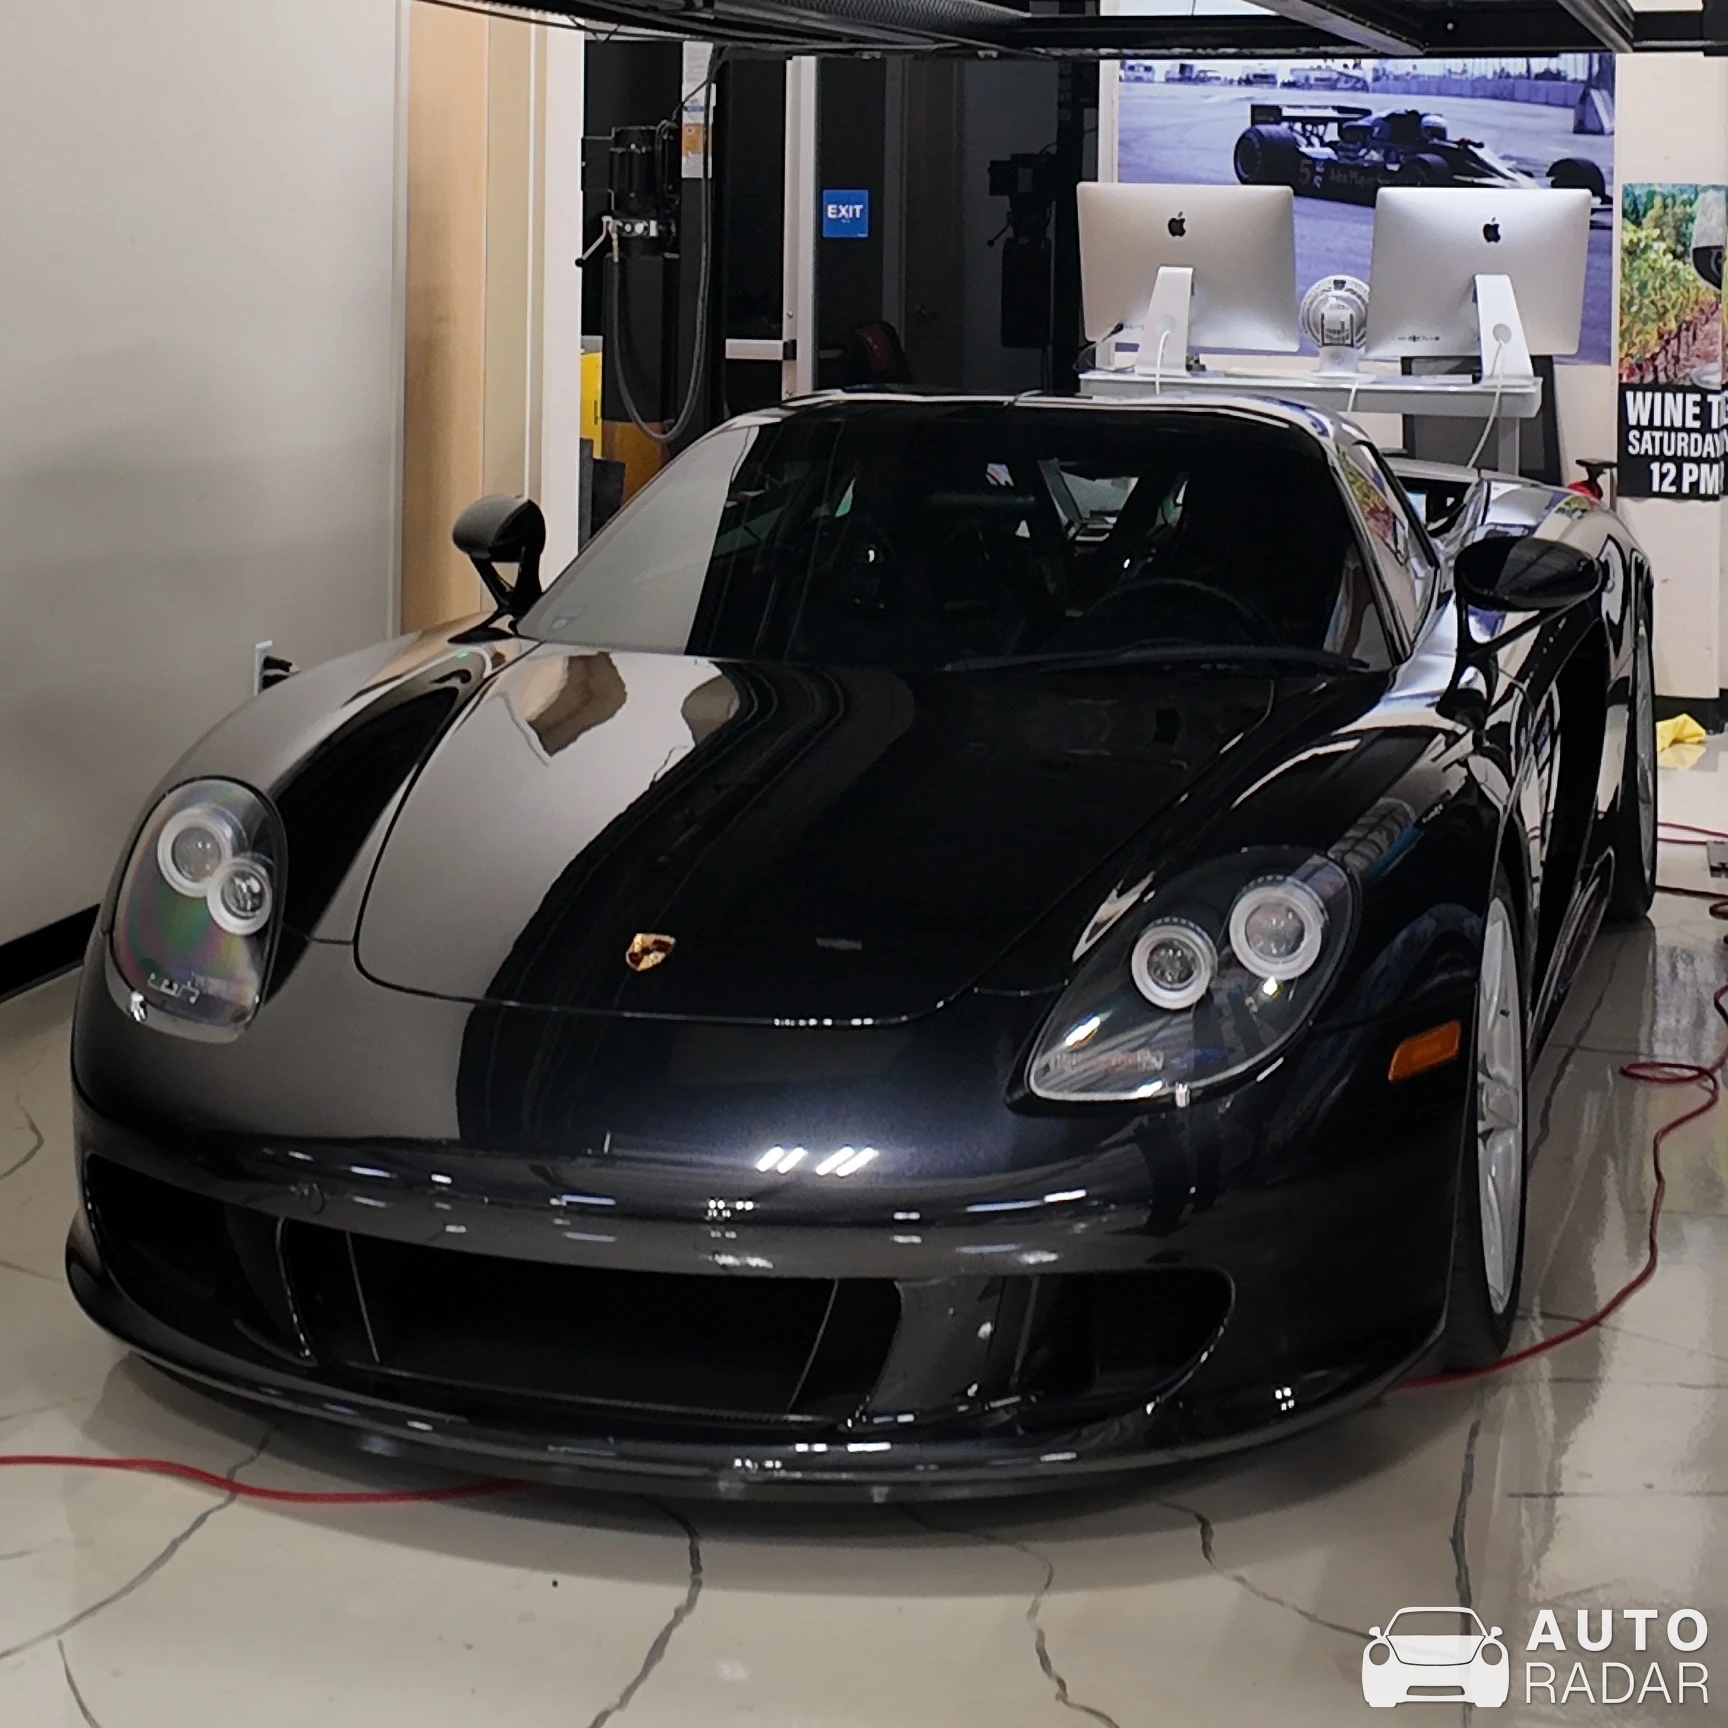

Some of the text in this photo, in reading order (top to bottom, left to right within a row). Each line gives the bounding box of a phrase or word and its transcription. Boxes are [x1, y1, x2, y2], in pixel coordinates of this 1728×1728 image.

[827, 204, 864, 219] EXIT
[1625, 391, 1702, 429] WINE
[1650, 461, 1720, 495] 12 PM
